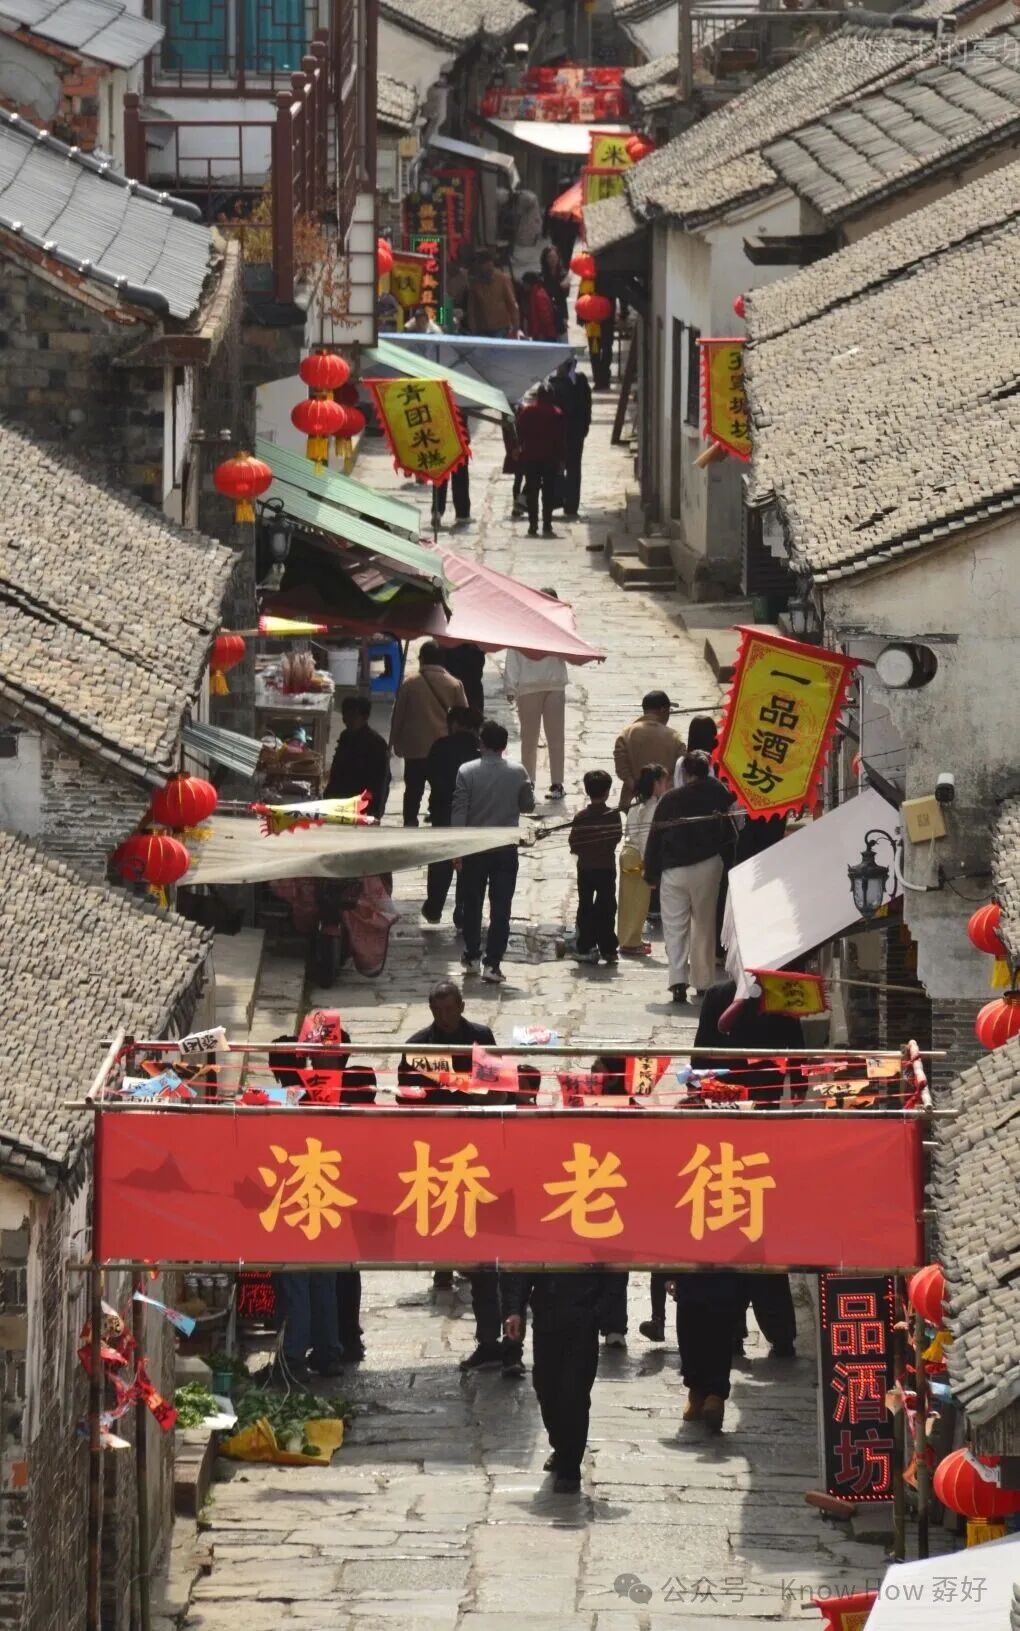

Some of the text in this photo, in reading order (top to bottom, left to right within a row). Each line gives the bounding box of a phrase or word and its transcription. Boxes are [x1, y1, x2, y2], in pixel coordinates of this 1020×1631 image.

[741, 669, 812, 795] 一品酒坊
[257, 1136, 778, 1243] 漆桥老街
